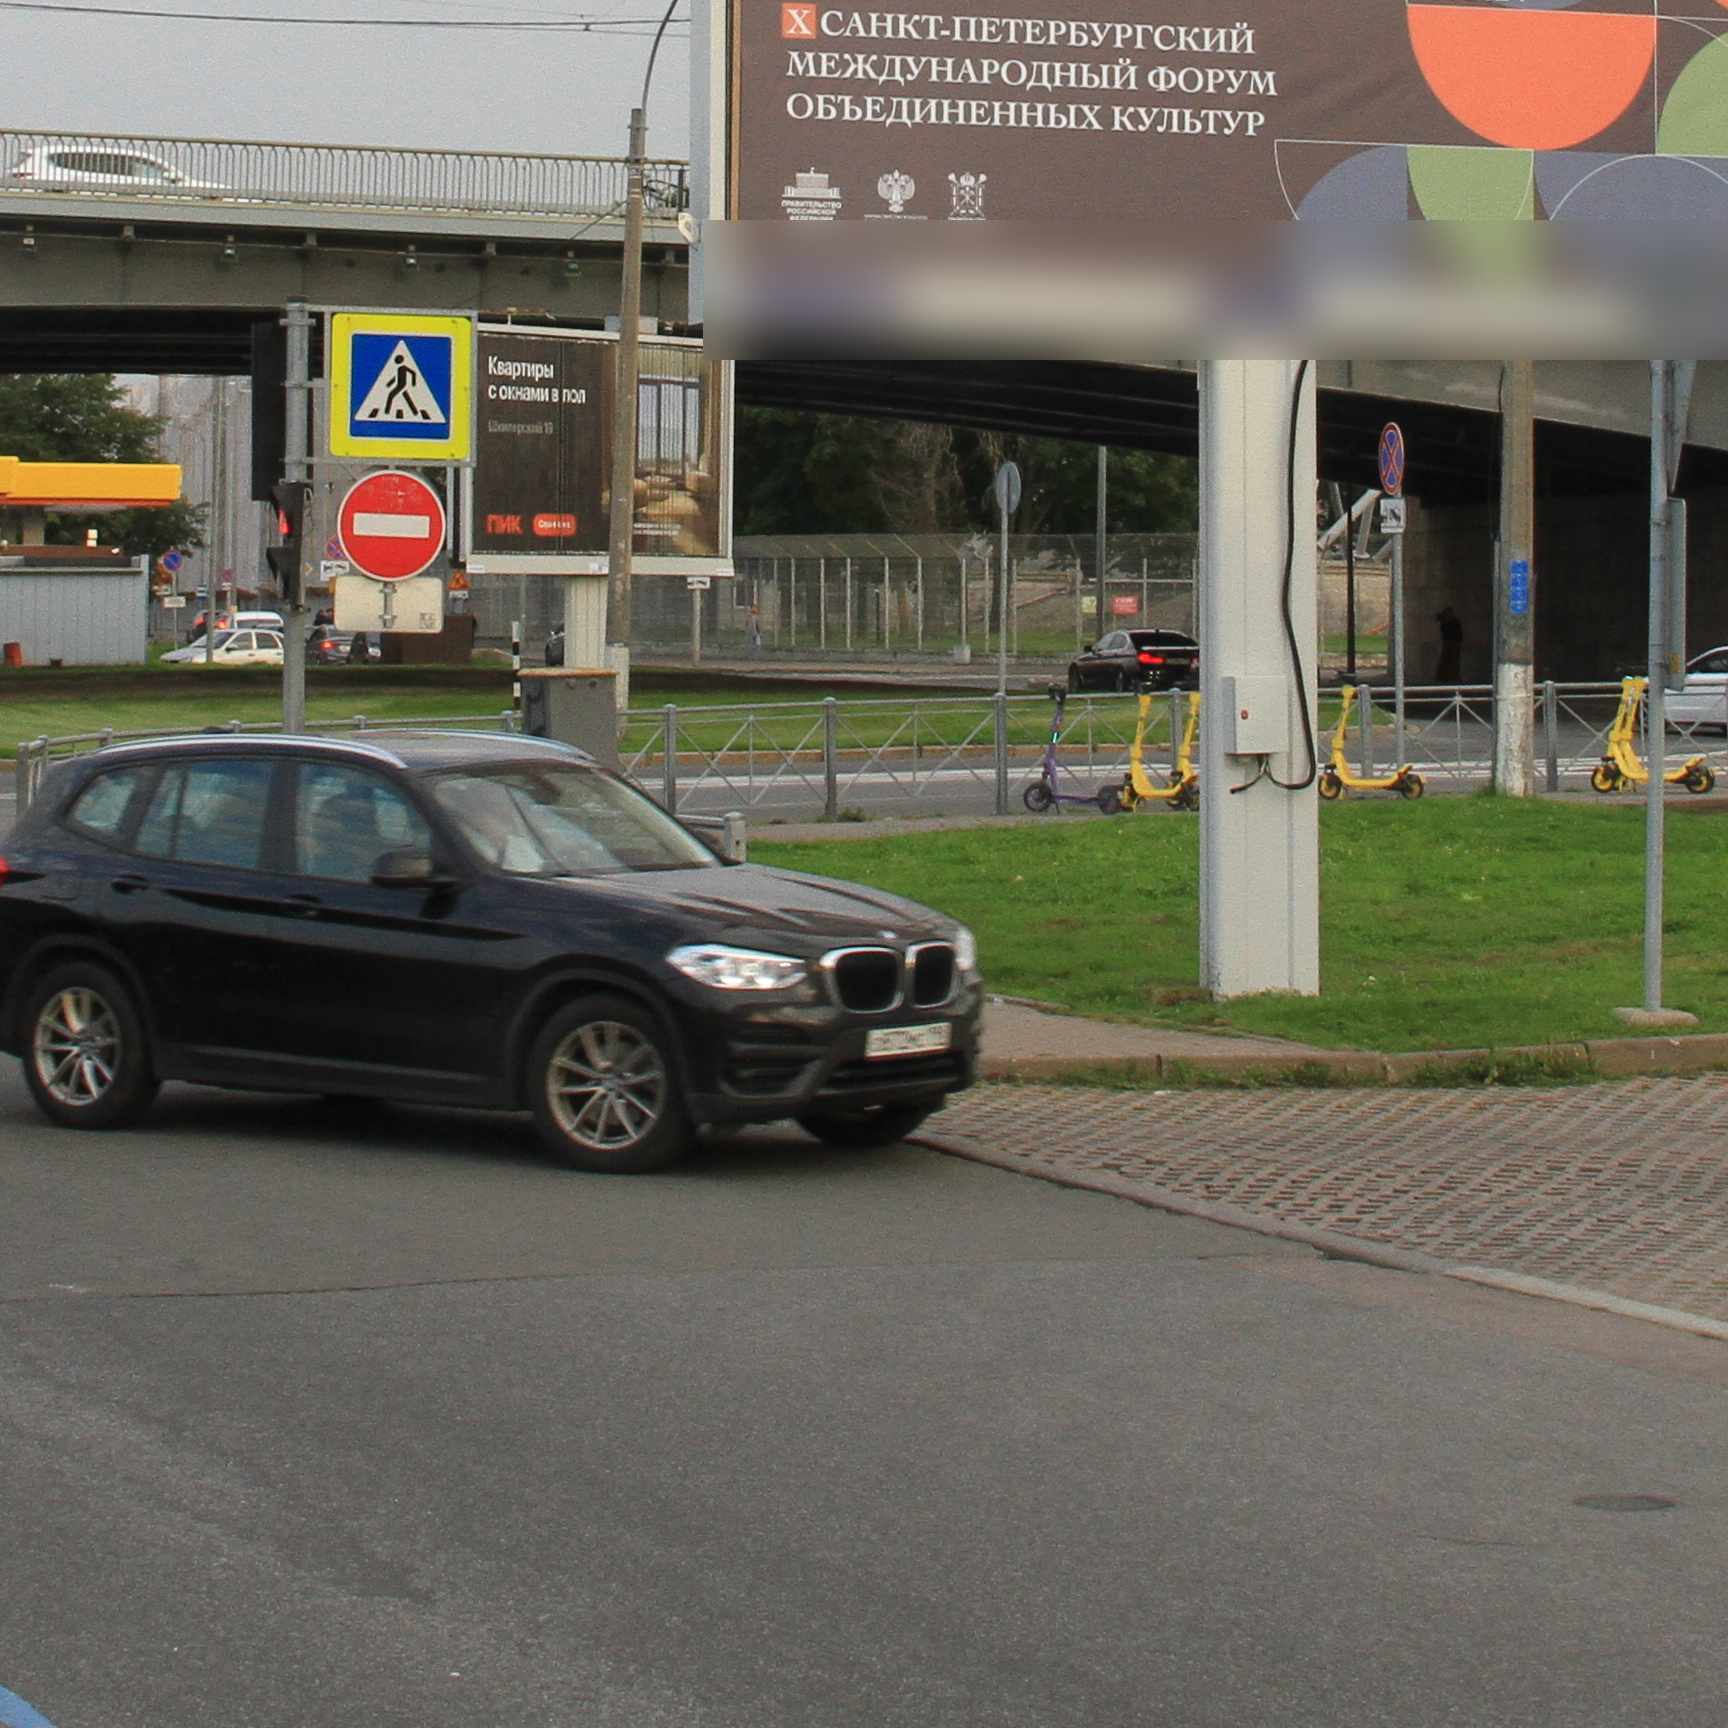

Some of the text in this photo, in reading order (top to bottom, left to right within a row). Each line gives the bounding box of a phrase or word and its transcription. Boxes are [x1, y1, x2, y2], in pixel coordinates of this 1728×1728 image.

[820, 9, 1256, 54] САНКТ-ПЕТЕРБУРГСКИЙ
[786, 51, 1278, 96] МЕЖДУНАРОДНЫЙ ФОРУМ
[786, 93, 1265, 136] ОБЪЕДИНЕННЫХ КУЛЬТУР
[488, 355, 554, 382] Квартиры
[488, 384, 586, 404] с окнами в пол
[487, 514, 523, 535] ПИК
